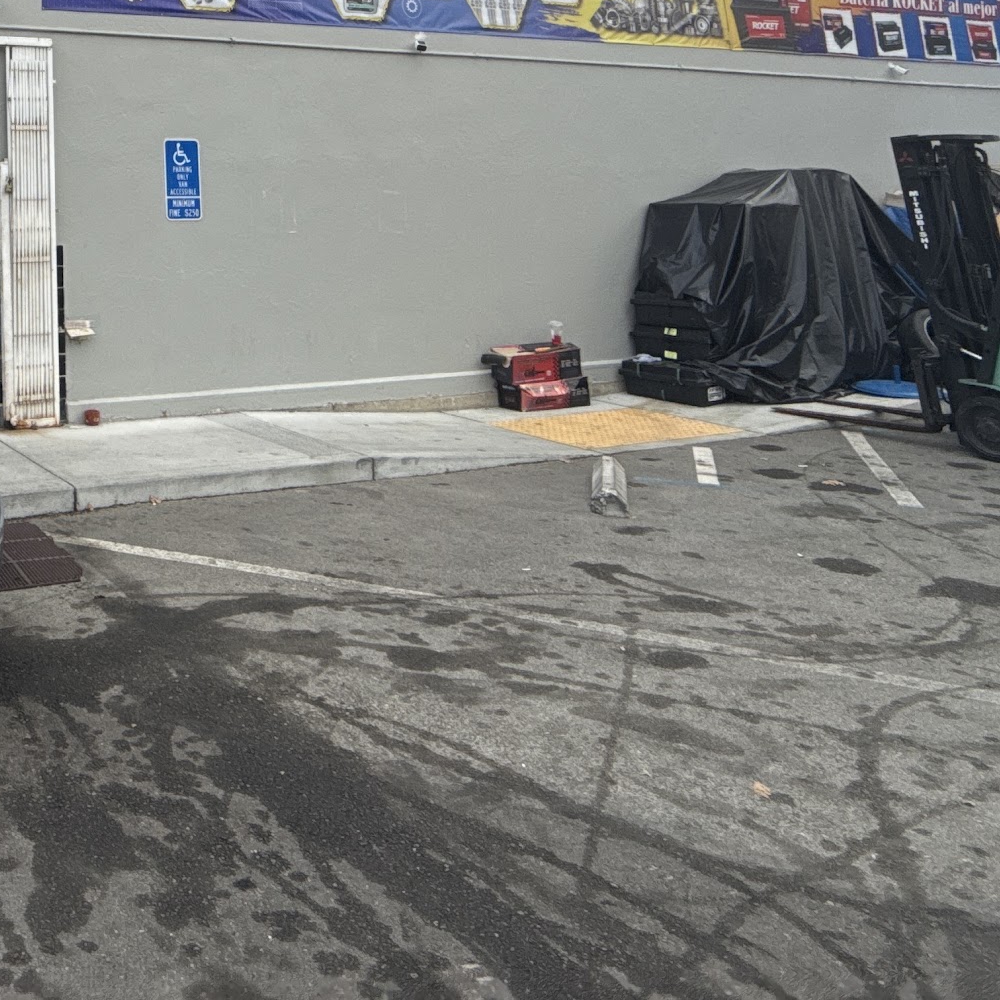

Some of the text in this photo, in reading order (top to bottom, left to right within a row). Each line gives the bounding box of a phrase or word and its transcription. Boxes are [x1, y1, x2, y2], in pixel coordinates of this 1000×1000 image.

[948, 1, 959, 14] al
[963, 2, 998, 19] mejor
[751, 20, 780, 31] ROCKET
[172, 199, 195, 208] MINIMUM
[169, 208, 181, 217] FINE
[908, 190, 929, 250] MITSUBISHI
